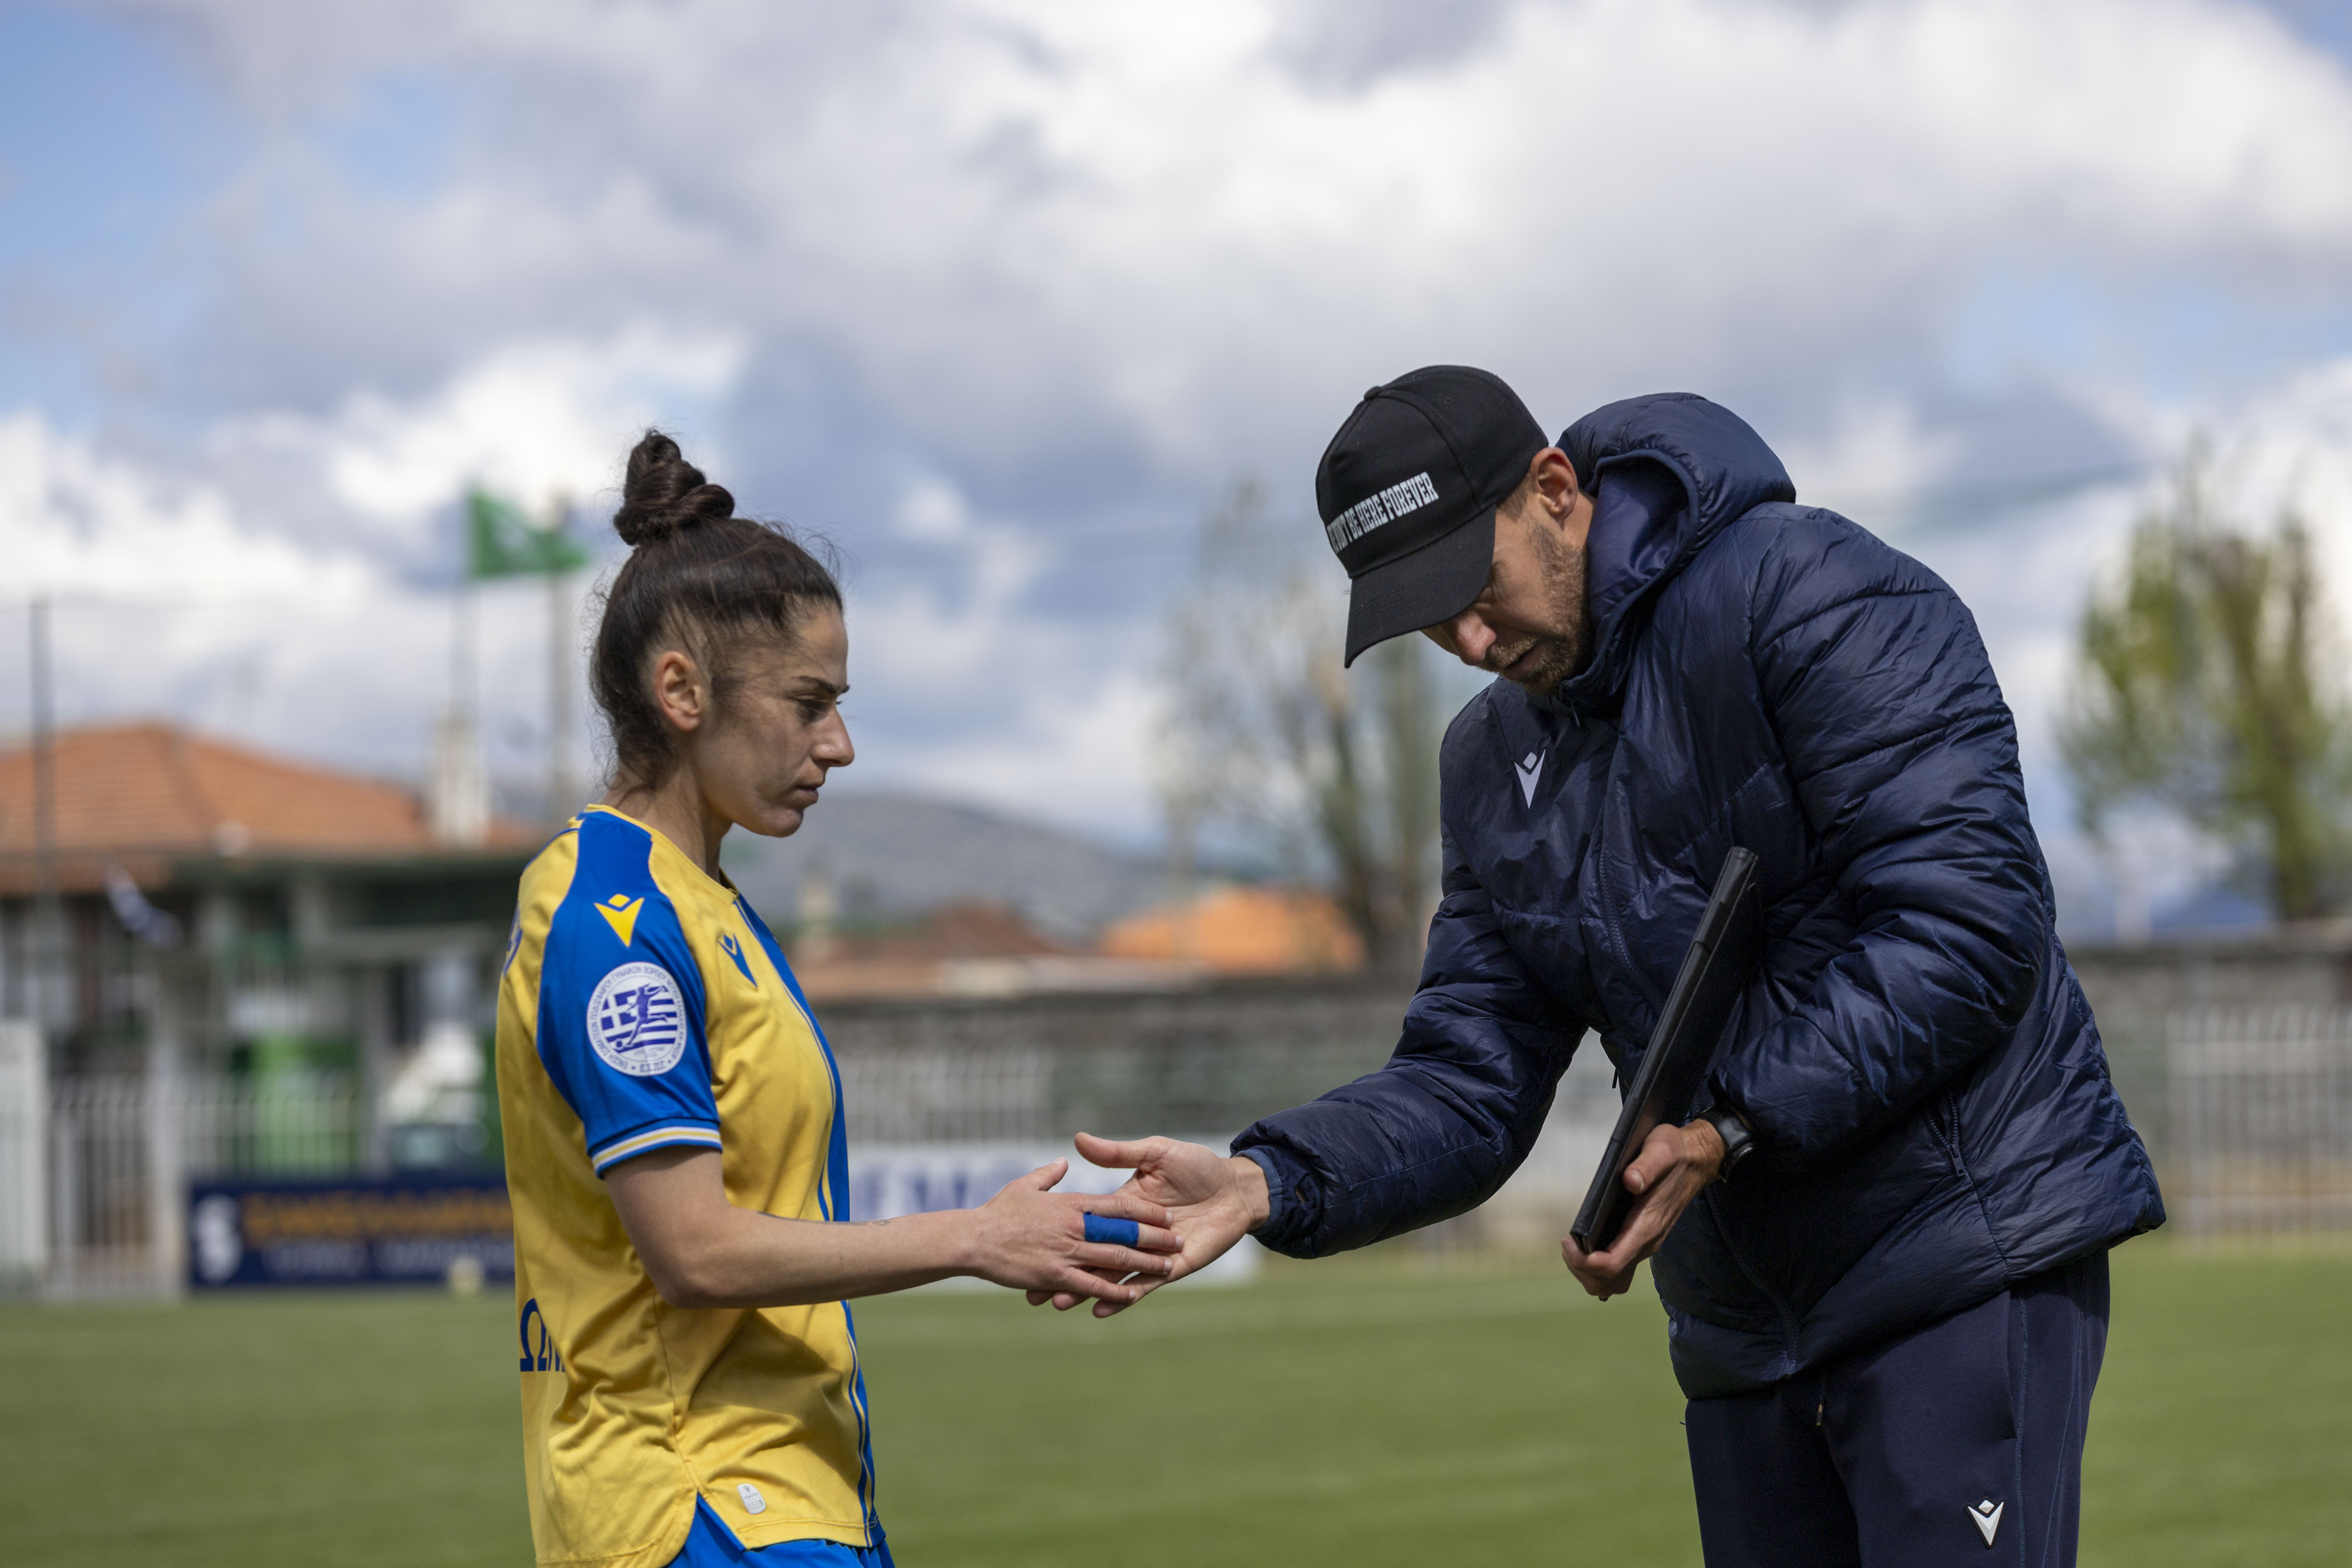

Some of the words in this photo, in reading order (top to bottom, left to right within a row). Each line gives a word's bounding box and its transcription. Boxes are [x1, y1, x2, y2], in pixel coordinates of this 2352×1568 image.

[1344, 507, 1364, 540] BE
[1354, 494, 1389, 534] HERE
[1379, 471, 1439, 521] FOREVER
